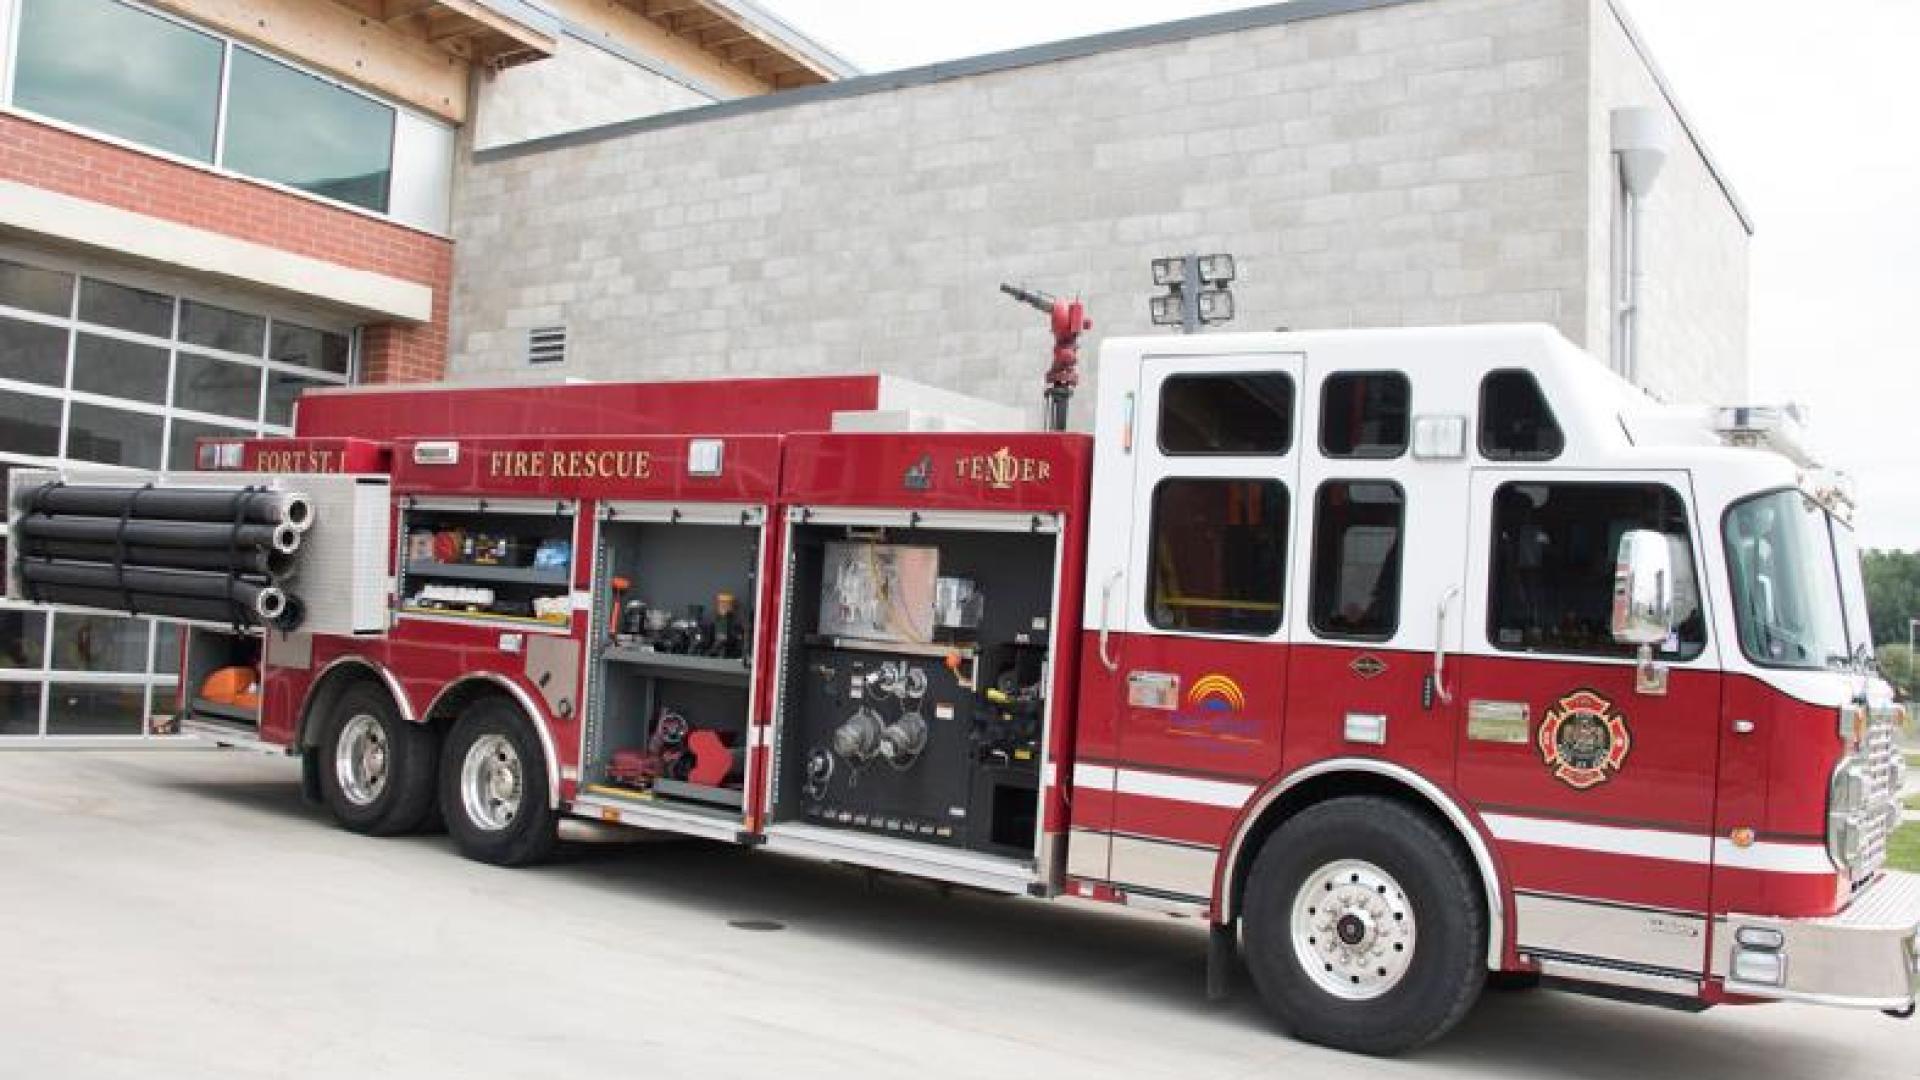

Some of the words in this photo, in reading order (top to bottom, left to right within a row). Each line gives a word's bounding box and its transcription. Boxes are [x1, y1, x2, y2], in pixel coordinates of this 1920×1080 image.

[257, 450, 306, 474] FORT
[490, 450, 545, 477] FIRE
[551, 450, 650, 478] RESCUE
[955, 455, 1050, 482] TENDER
